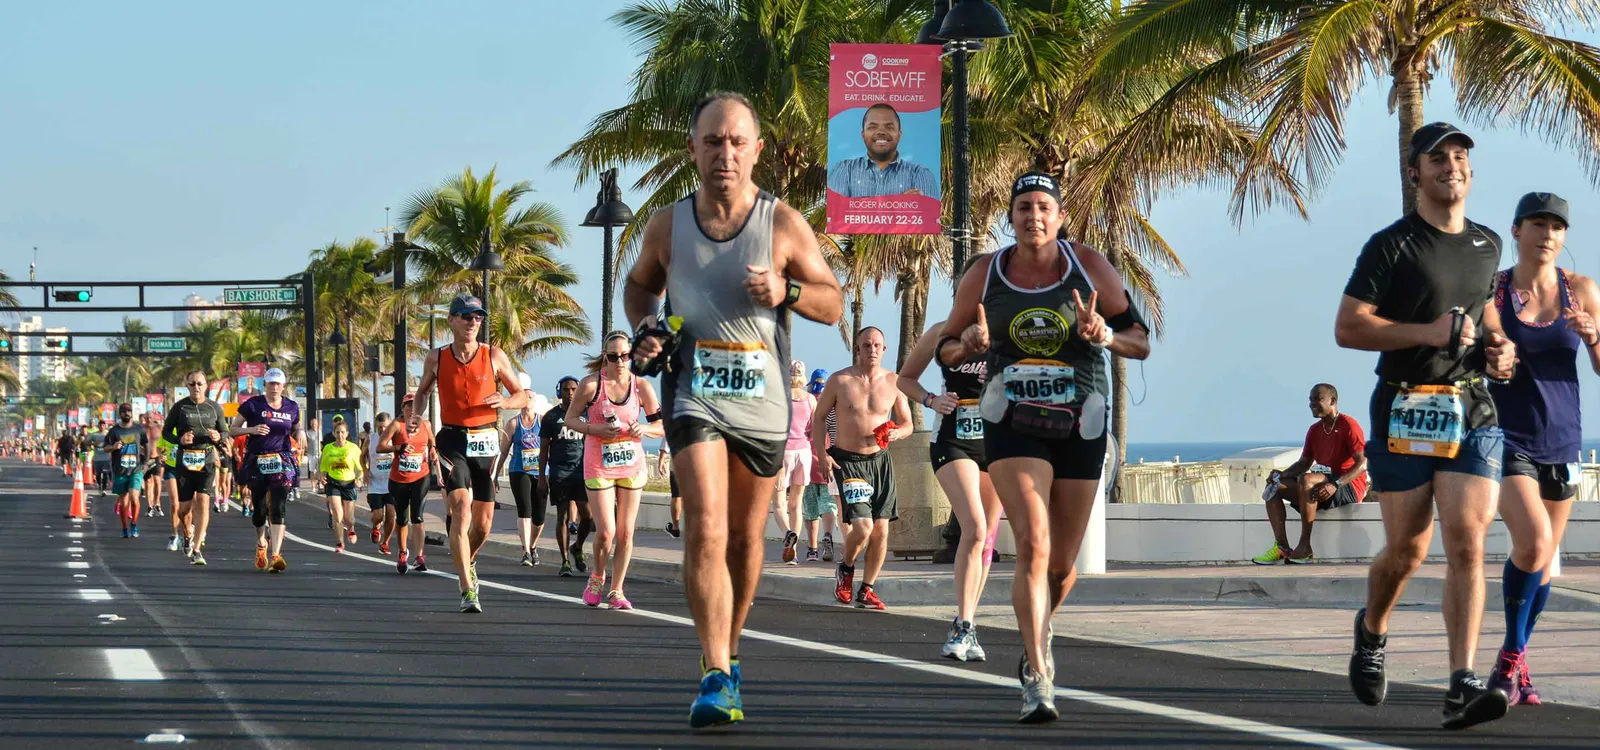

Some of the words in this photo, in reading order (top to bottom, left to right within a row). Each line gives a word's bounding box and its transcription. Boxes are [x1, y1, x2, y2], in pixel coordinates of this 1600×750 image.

[845, 70, 926, 88] SOBEWFF
[849, 201, 877, 209] ROGER
[878, 201, 919, 209] MOOKING
[844, 215, 894, 224] FEBRUARY
[895, 215, 923, 225] 22-26
[702, 366, 756, 390] 2388
[1014, 378, 1066, 398] 4056
[1403, 408, 1449, 432] 4737
[606, 450, 633, 463] 3645
